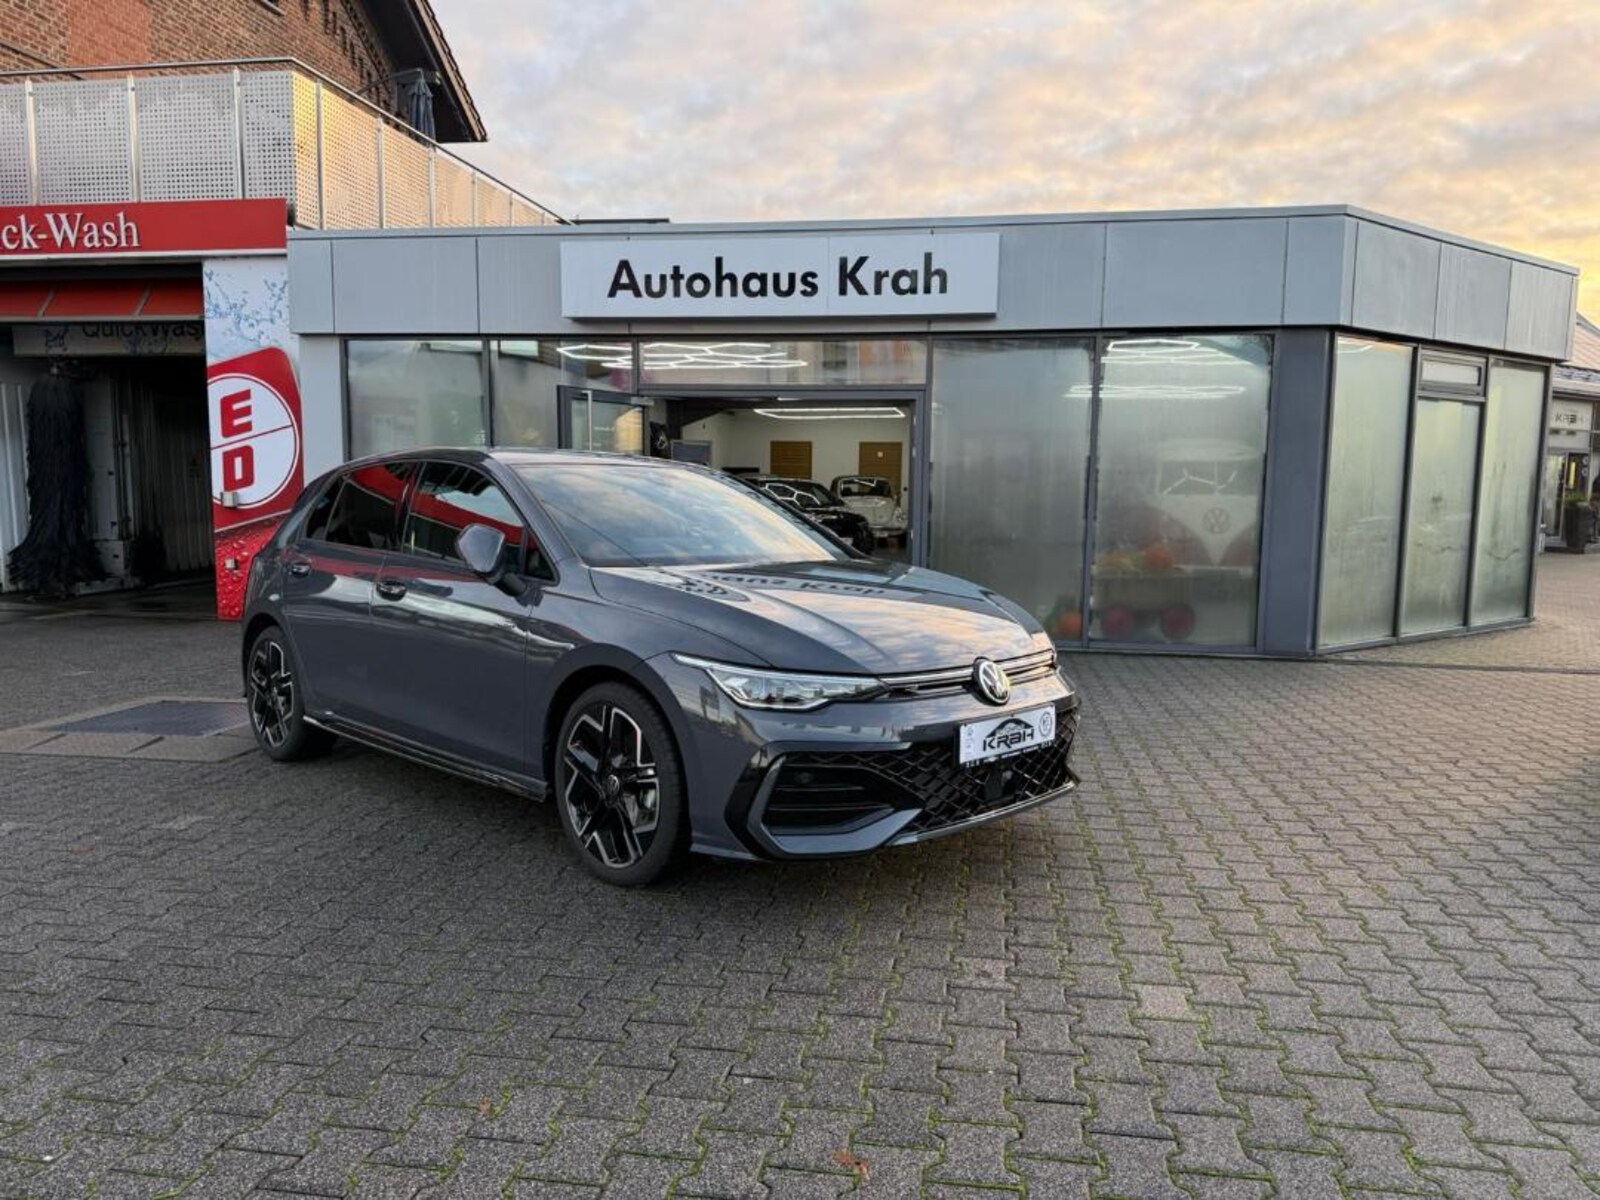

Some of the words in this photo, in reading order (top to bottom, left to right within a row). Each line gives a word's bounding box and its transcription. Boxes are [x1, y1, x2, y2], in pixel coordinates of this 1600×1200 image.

[0, 211, 140, 250] ck-Wash
[607, 256, 819, 298] Autohaus
[838, 252, 948, 296] Krah
